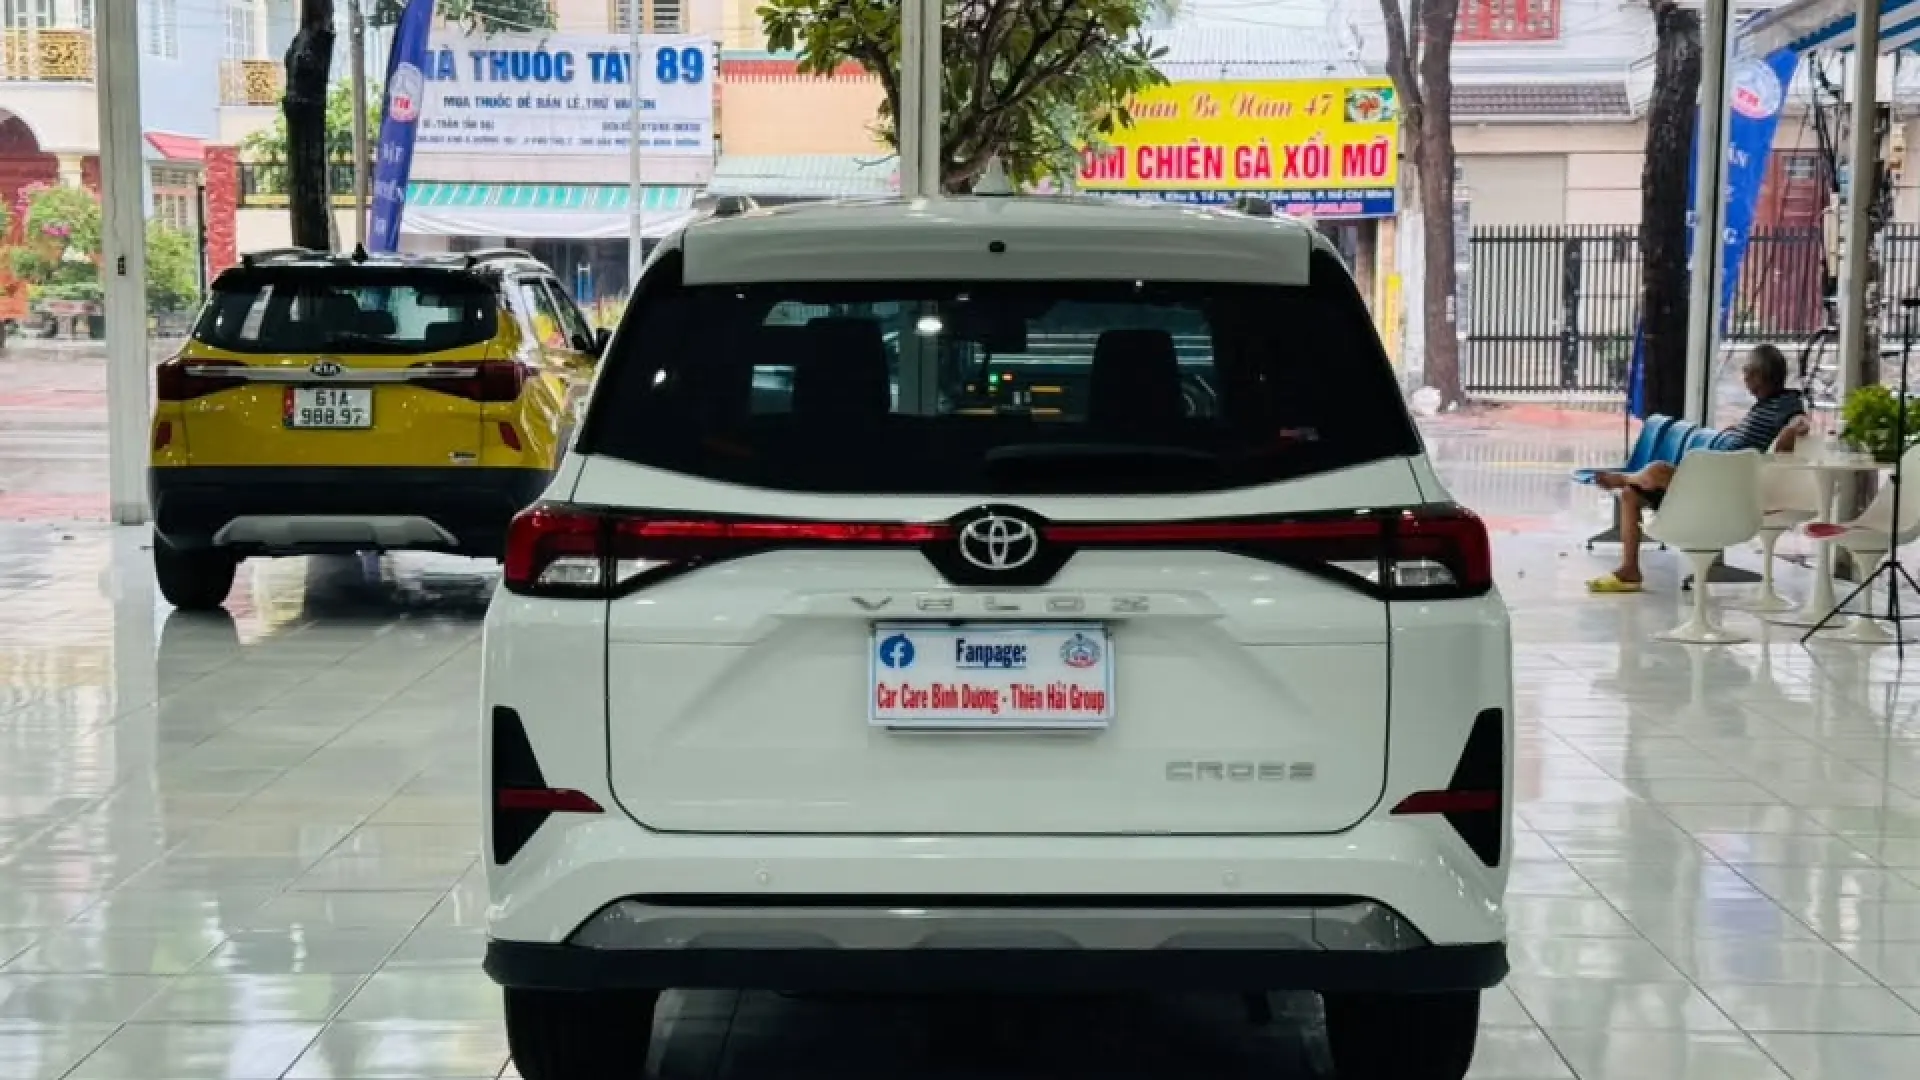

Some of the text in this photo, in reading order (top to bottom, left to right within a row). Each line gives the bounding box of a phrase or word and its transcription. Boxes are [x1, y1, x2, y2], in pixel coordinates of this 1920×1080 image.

[467, 40, 575, 82] THUỐC
[656, 45, 704, 84] 89
[1304, 93, 1334, 116] 47
[1136, 138, 1223, 179] CHIÊN
[1234, 137, 1271, 179] GÀ
[1283, 131, 1330, 179] XỐI
[315, 390, 349, 406] 61A
[851, 594, 1150, 613] VELOZ
[956, 637, 1027, 667] Fanpage:
[877, 683, 897, 709] Car
[902, 683, 929, 709] Care
[1070, 683, 1105, 716] Group
[1165, 761, 1315, 782] CROSS
